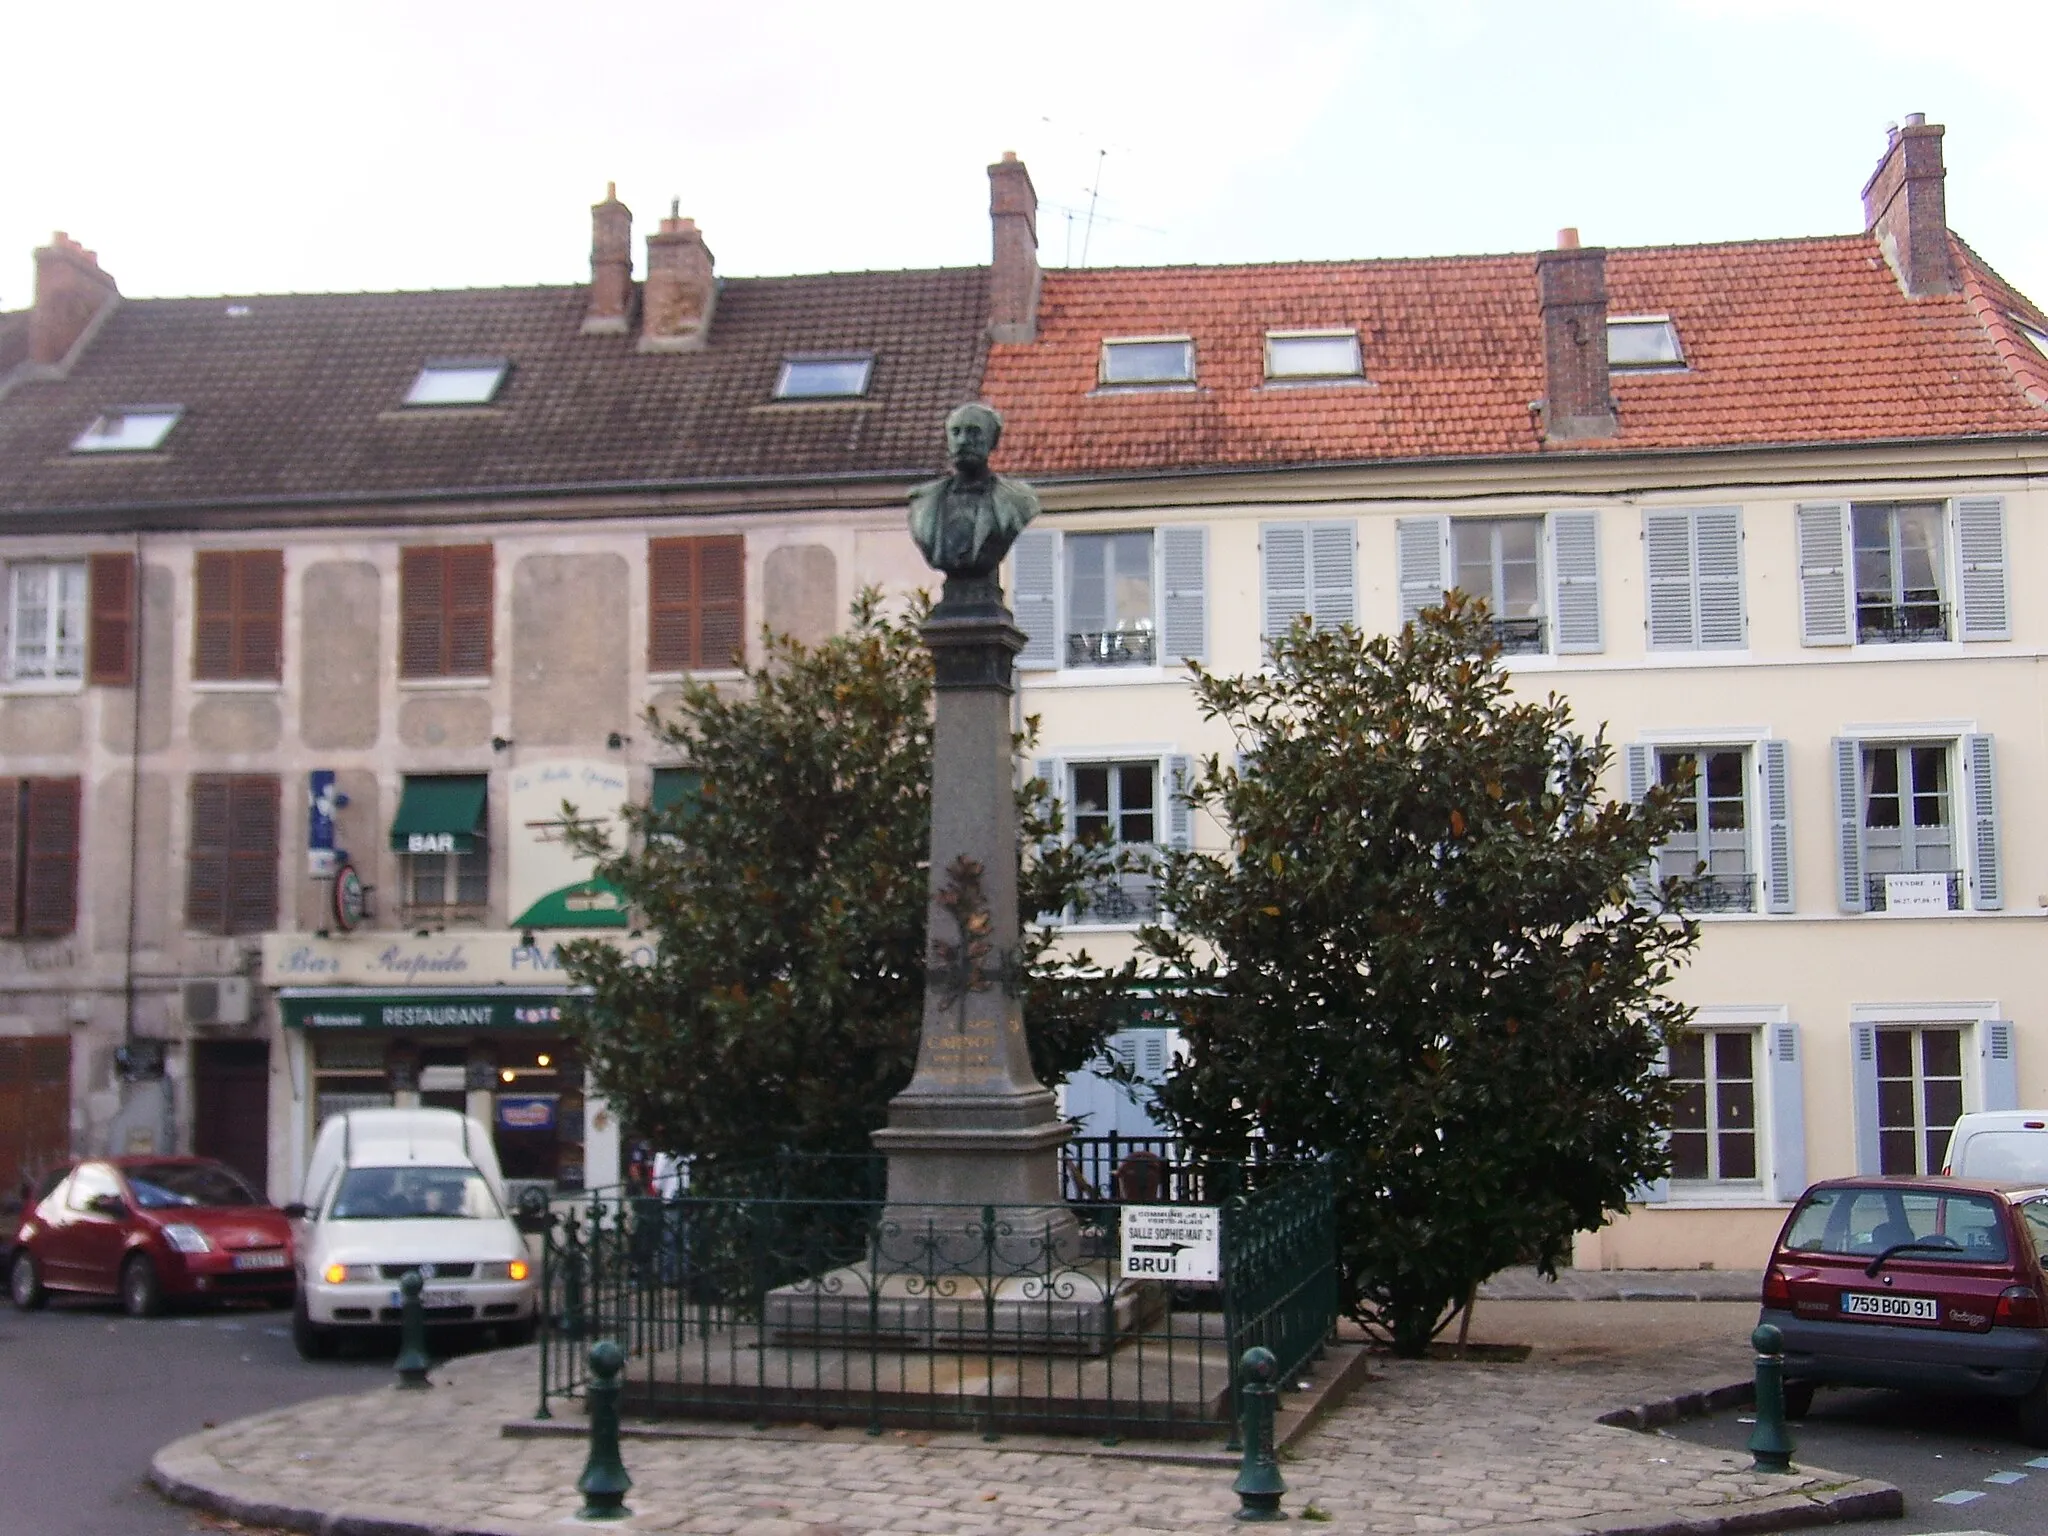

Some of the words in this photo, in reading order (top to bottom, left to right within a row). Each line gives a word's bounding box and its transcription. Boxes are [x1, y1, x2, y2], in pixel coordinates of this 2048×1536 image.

[408, 832, 455, 852] BAR
[382, 1006, 493, 1025] RESTAURANT
[1129, 1227, 1153, 1239] SALLE
[1851, 1295, 1879, 1312] 759
[1914, 1300, 1933, 1316] 91
